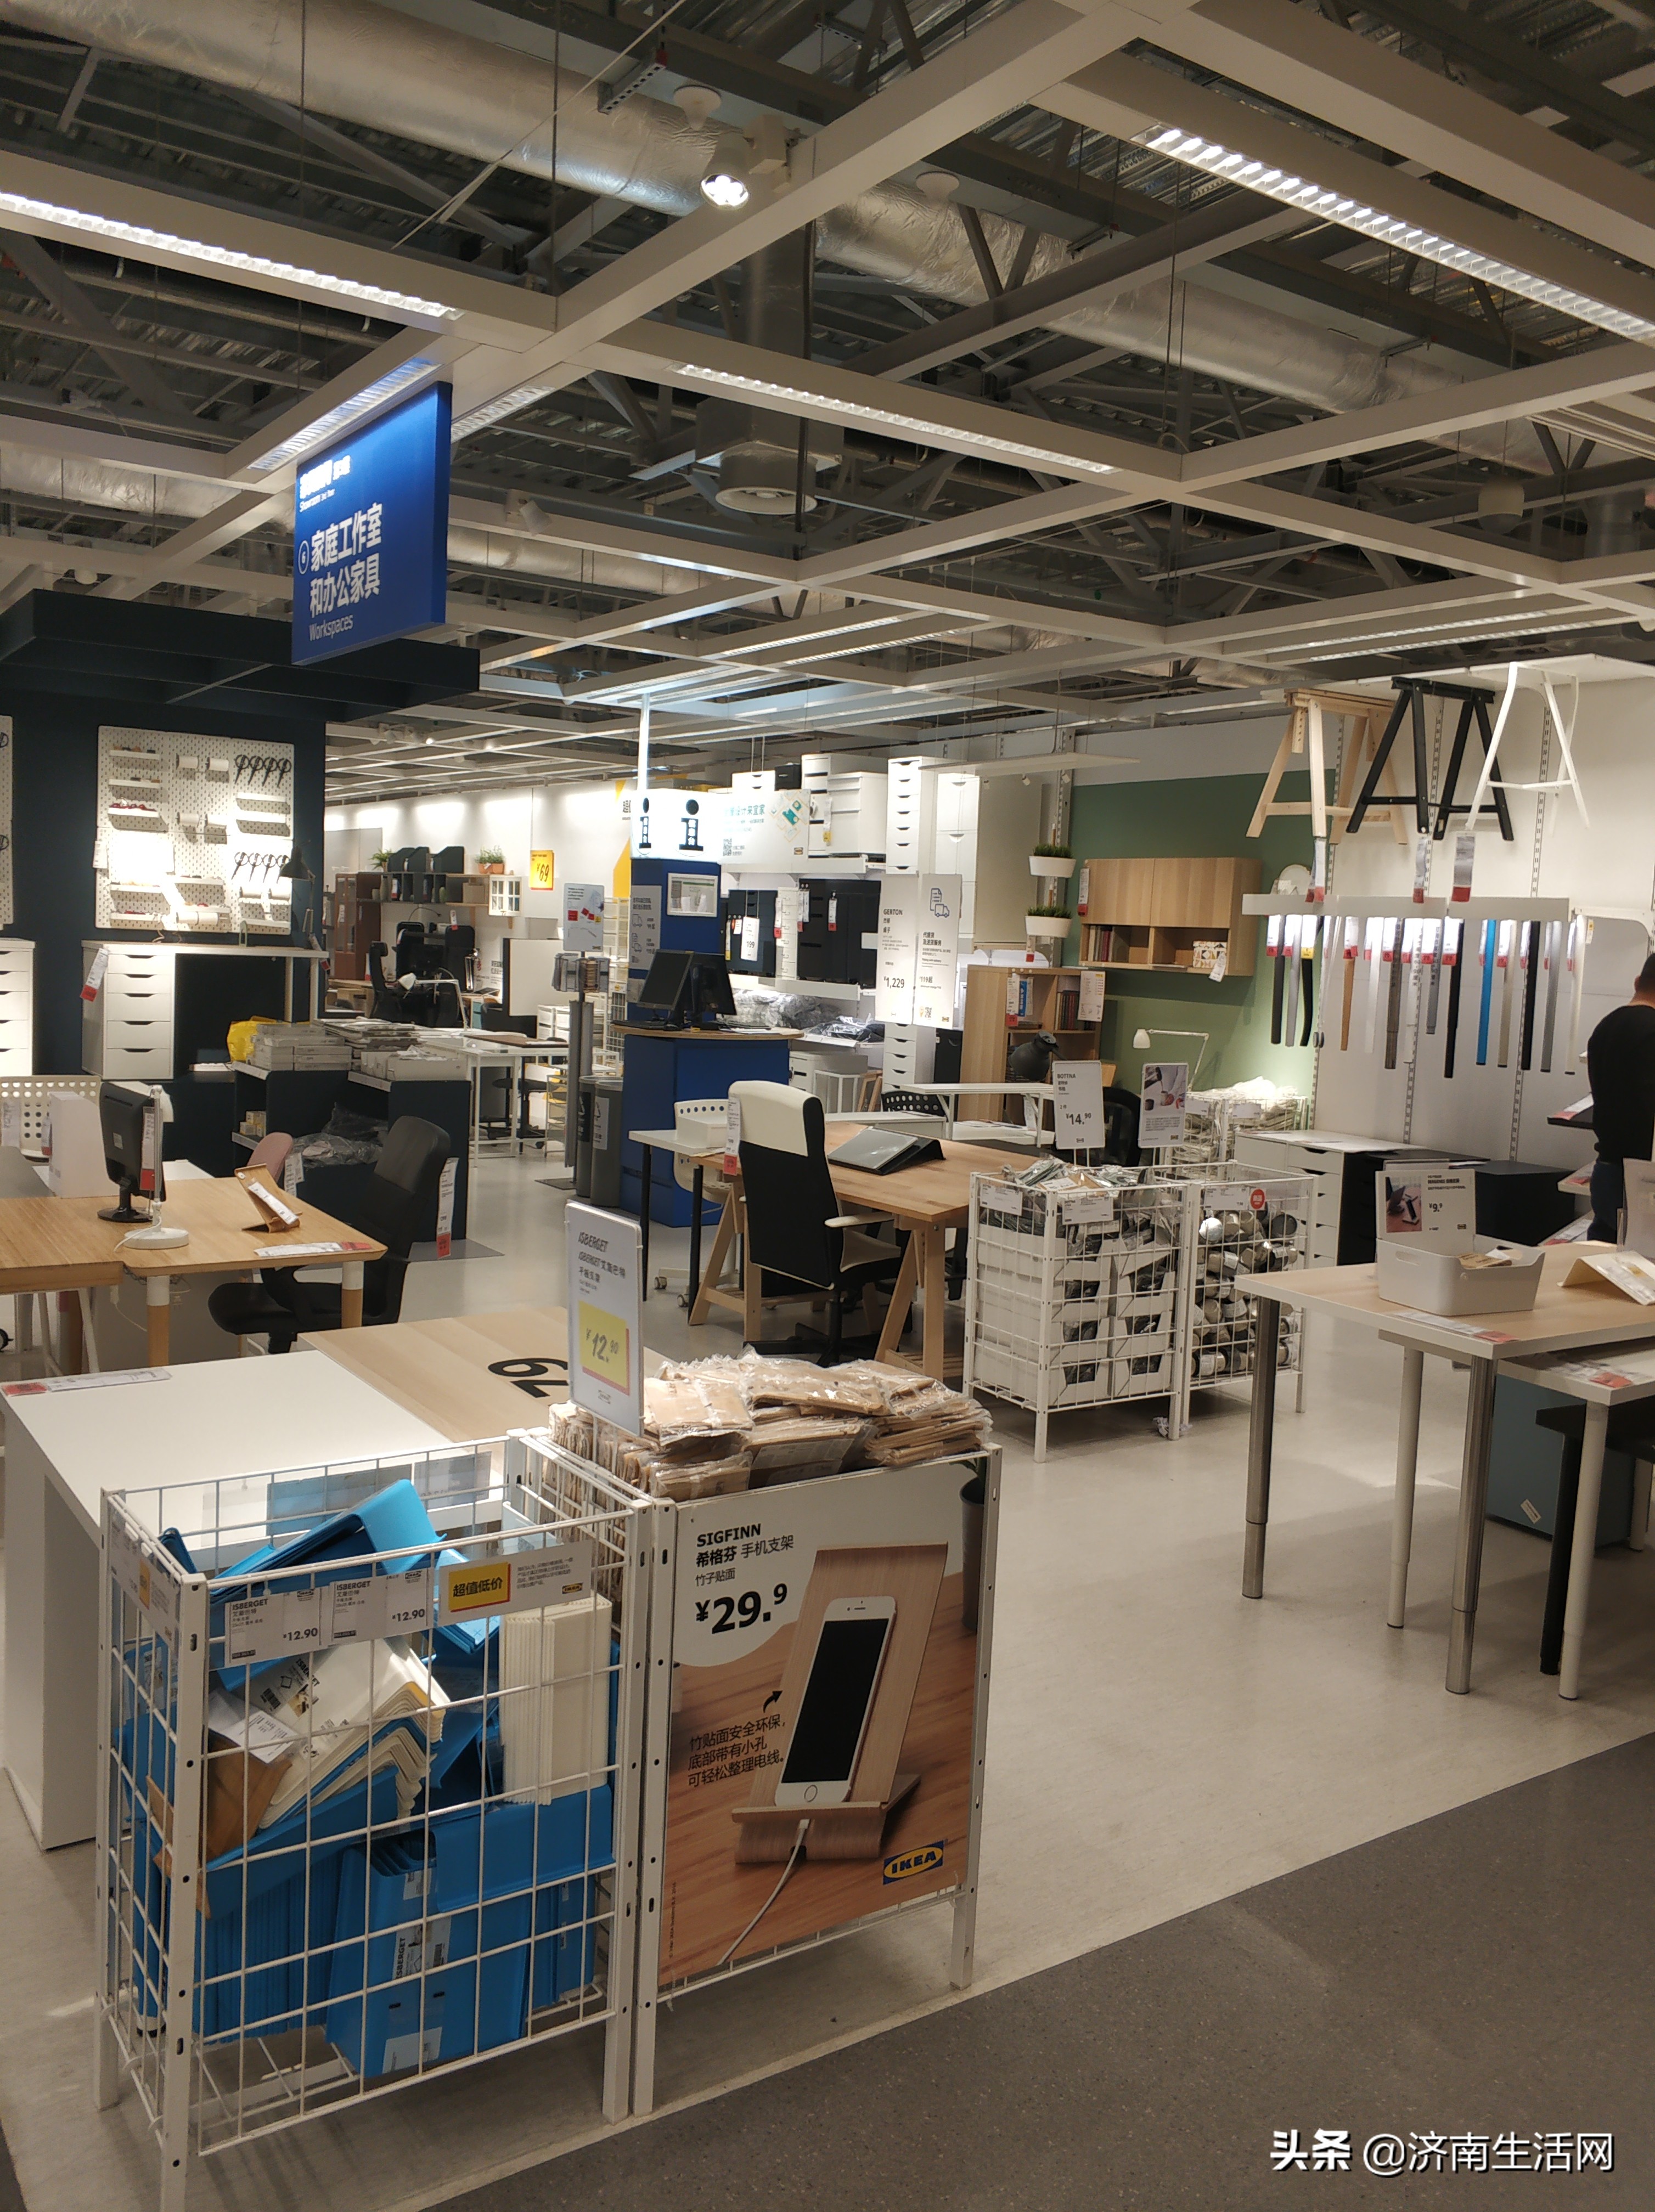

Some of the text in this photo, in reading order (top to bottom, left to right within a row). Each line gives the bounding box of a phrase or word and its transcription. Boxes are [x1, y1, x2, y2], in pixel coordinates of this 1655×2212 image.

[311, 501, 383, 572] 家庭工作室
[309, 552, 381, 618] 和办公家具
[308, 614, 353, 641] Workspaces
[883, 975, 905, 989] ¥1,229
[1066, 1113, 1091, 1125] ¥14.90
[1428, 1203, 1443, 1213] ¥9.9
[578, 1232, 609, 1252] ISBERGET
[586, 1328, 619, 1363] ¥12.90
[696, 1523, 761, 1548] SIGFINN
[696, 1534, 794, 1568] 希格芬 手机支架
[336, 1581, 371, 1591] ISBERGET
[453, 1576, 503, 1598] 超值低价
[695, 1567, 736, 1587] 竹子贴面
[232, 1598, 268, 1611] ISBERGET
[392, 1609, 425, 1622] ¥12.90
[695, 1583, 787, 1635] ¥29.9
[283, 1627, 318, 1641] ¥12.90
[296, 1658, 320, 1687] ISBERET
[688, 1735, 768, 1771] 底部带有小孔
[688, 1749, 784, 1787] 可轻松整理电线。
[891, 1849, 938, 1875] IKEA
